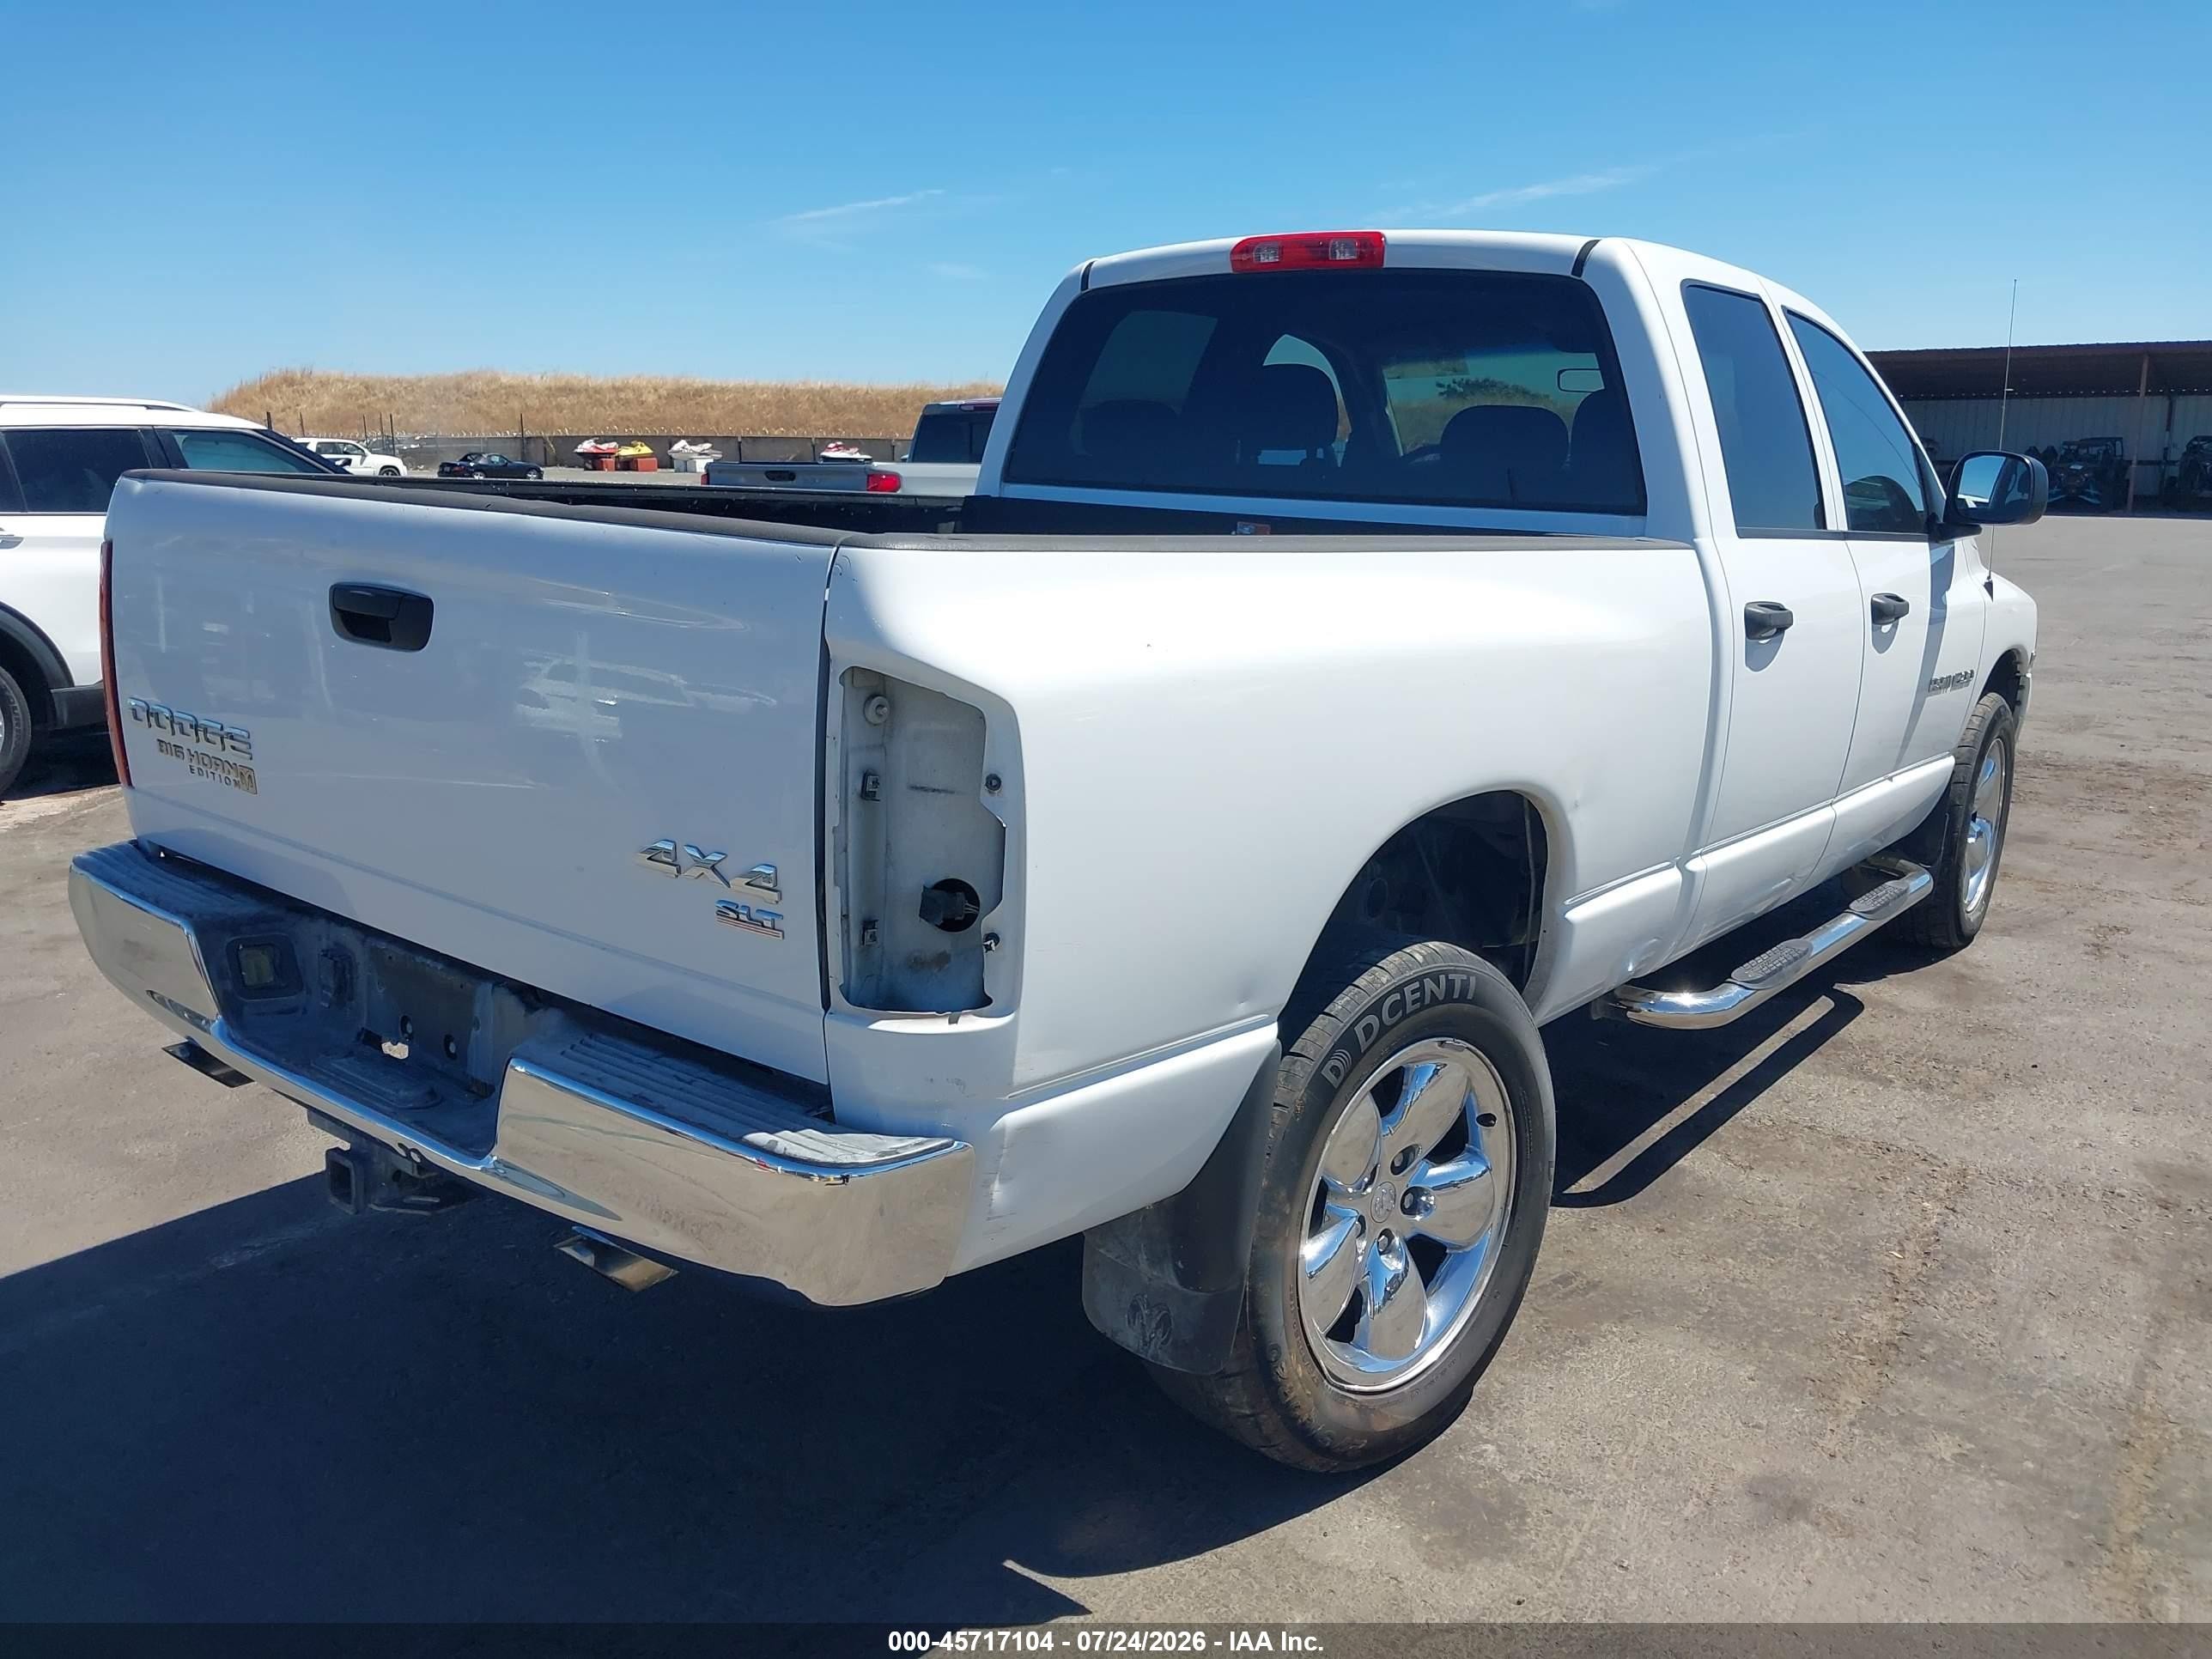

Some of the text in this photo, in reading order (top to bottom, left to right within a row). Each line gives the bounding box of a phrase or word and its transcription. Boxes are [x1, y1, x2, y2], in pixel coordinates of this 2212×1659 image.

[128, 696, 252, 761] DODGE
[156, 738, 238, 779] BIG HORN
[188, 764, 241, 790] EDITION
[637, 839, 782, 904] 4X4
[714, 899, 784, 932] SLT
[1353, 974, 1477, 1054] DCENTI
